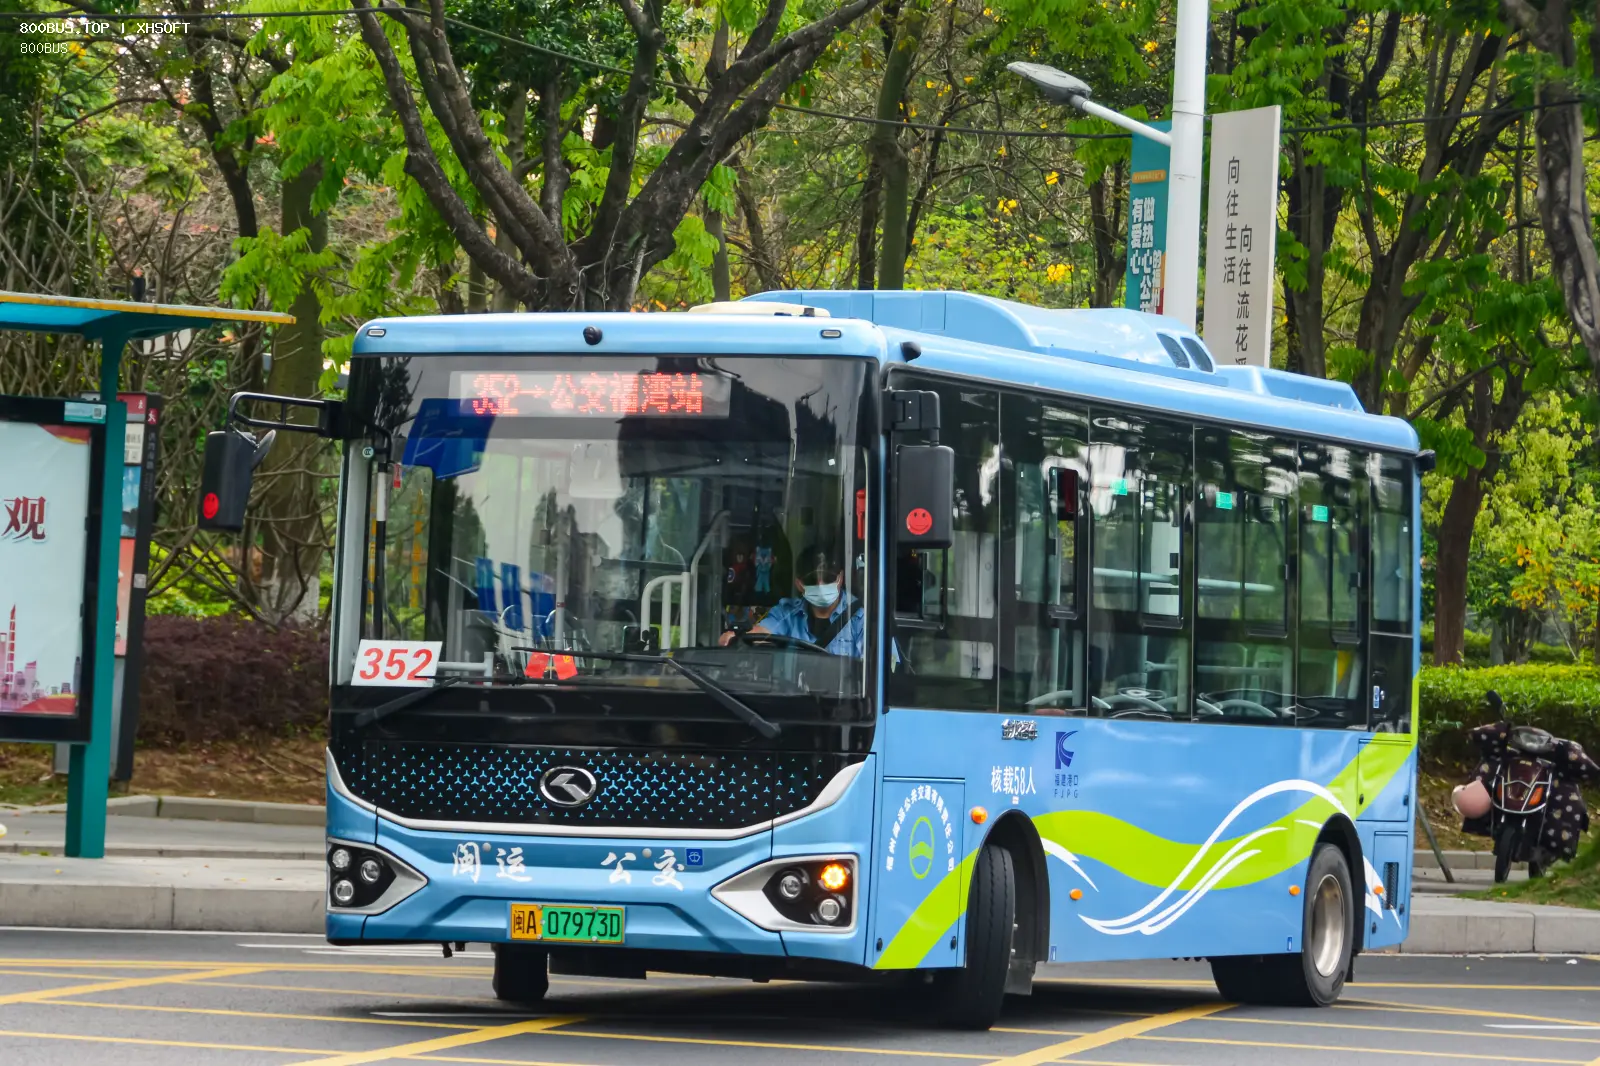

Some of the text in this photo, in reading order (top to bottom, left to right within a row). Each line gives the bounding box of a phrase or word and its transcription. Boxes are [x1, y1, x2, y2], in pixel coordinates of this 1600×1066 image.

[1130, 197, 1144, 275] 有爱心
[1222, 156, 1240, 284] 向往生活
[1, 496, 47, 540] 观
[360, 648, 433, 681] 352
[991, 766, 1037, 795] 核载58人
[453, 841, 685, 892] 闽运 公交
